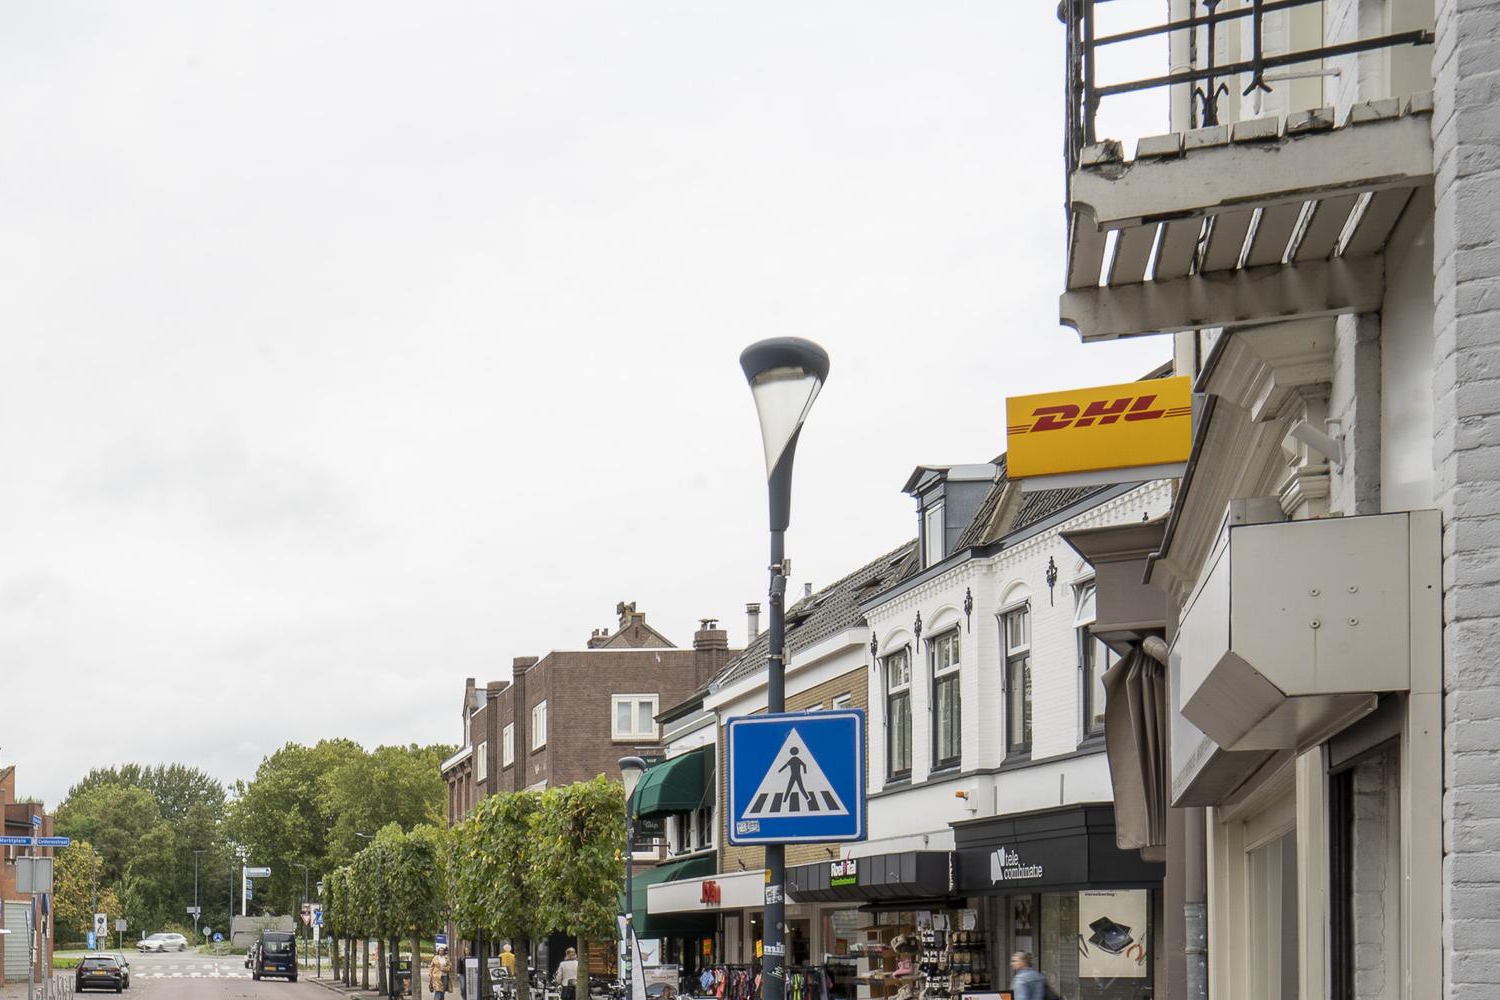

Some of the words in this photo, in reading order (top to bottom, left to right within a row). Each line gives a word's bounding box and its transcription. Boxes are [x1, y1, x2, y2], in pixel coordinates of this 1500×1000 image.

[1030, 395, 1166, 432] DHL
[1005, 850, 1018, 866] tele
[1004, 863, 1042, 879] combinatie
